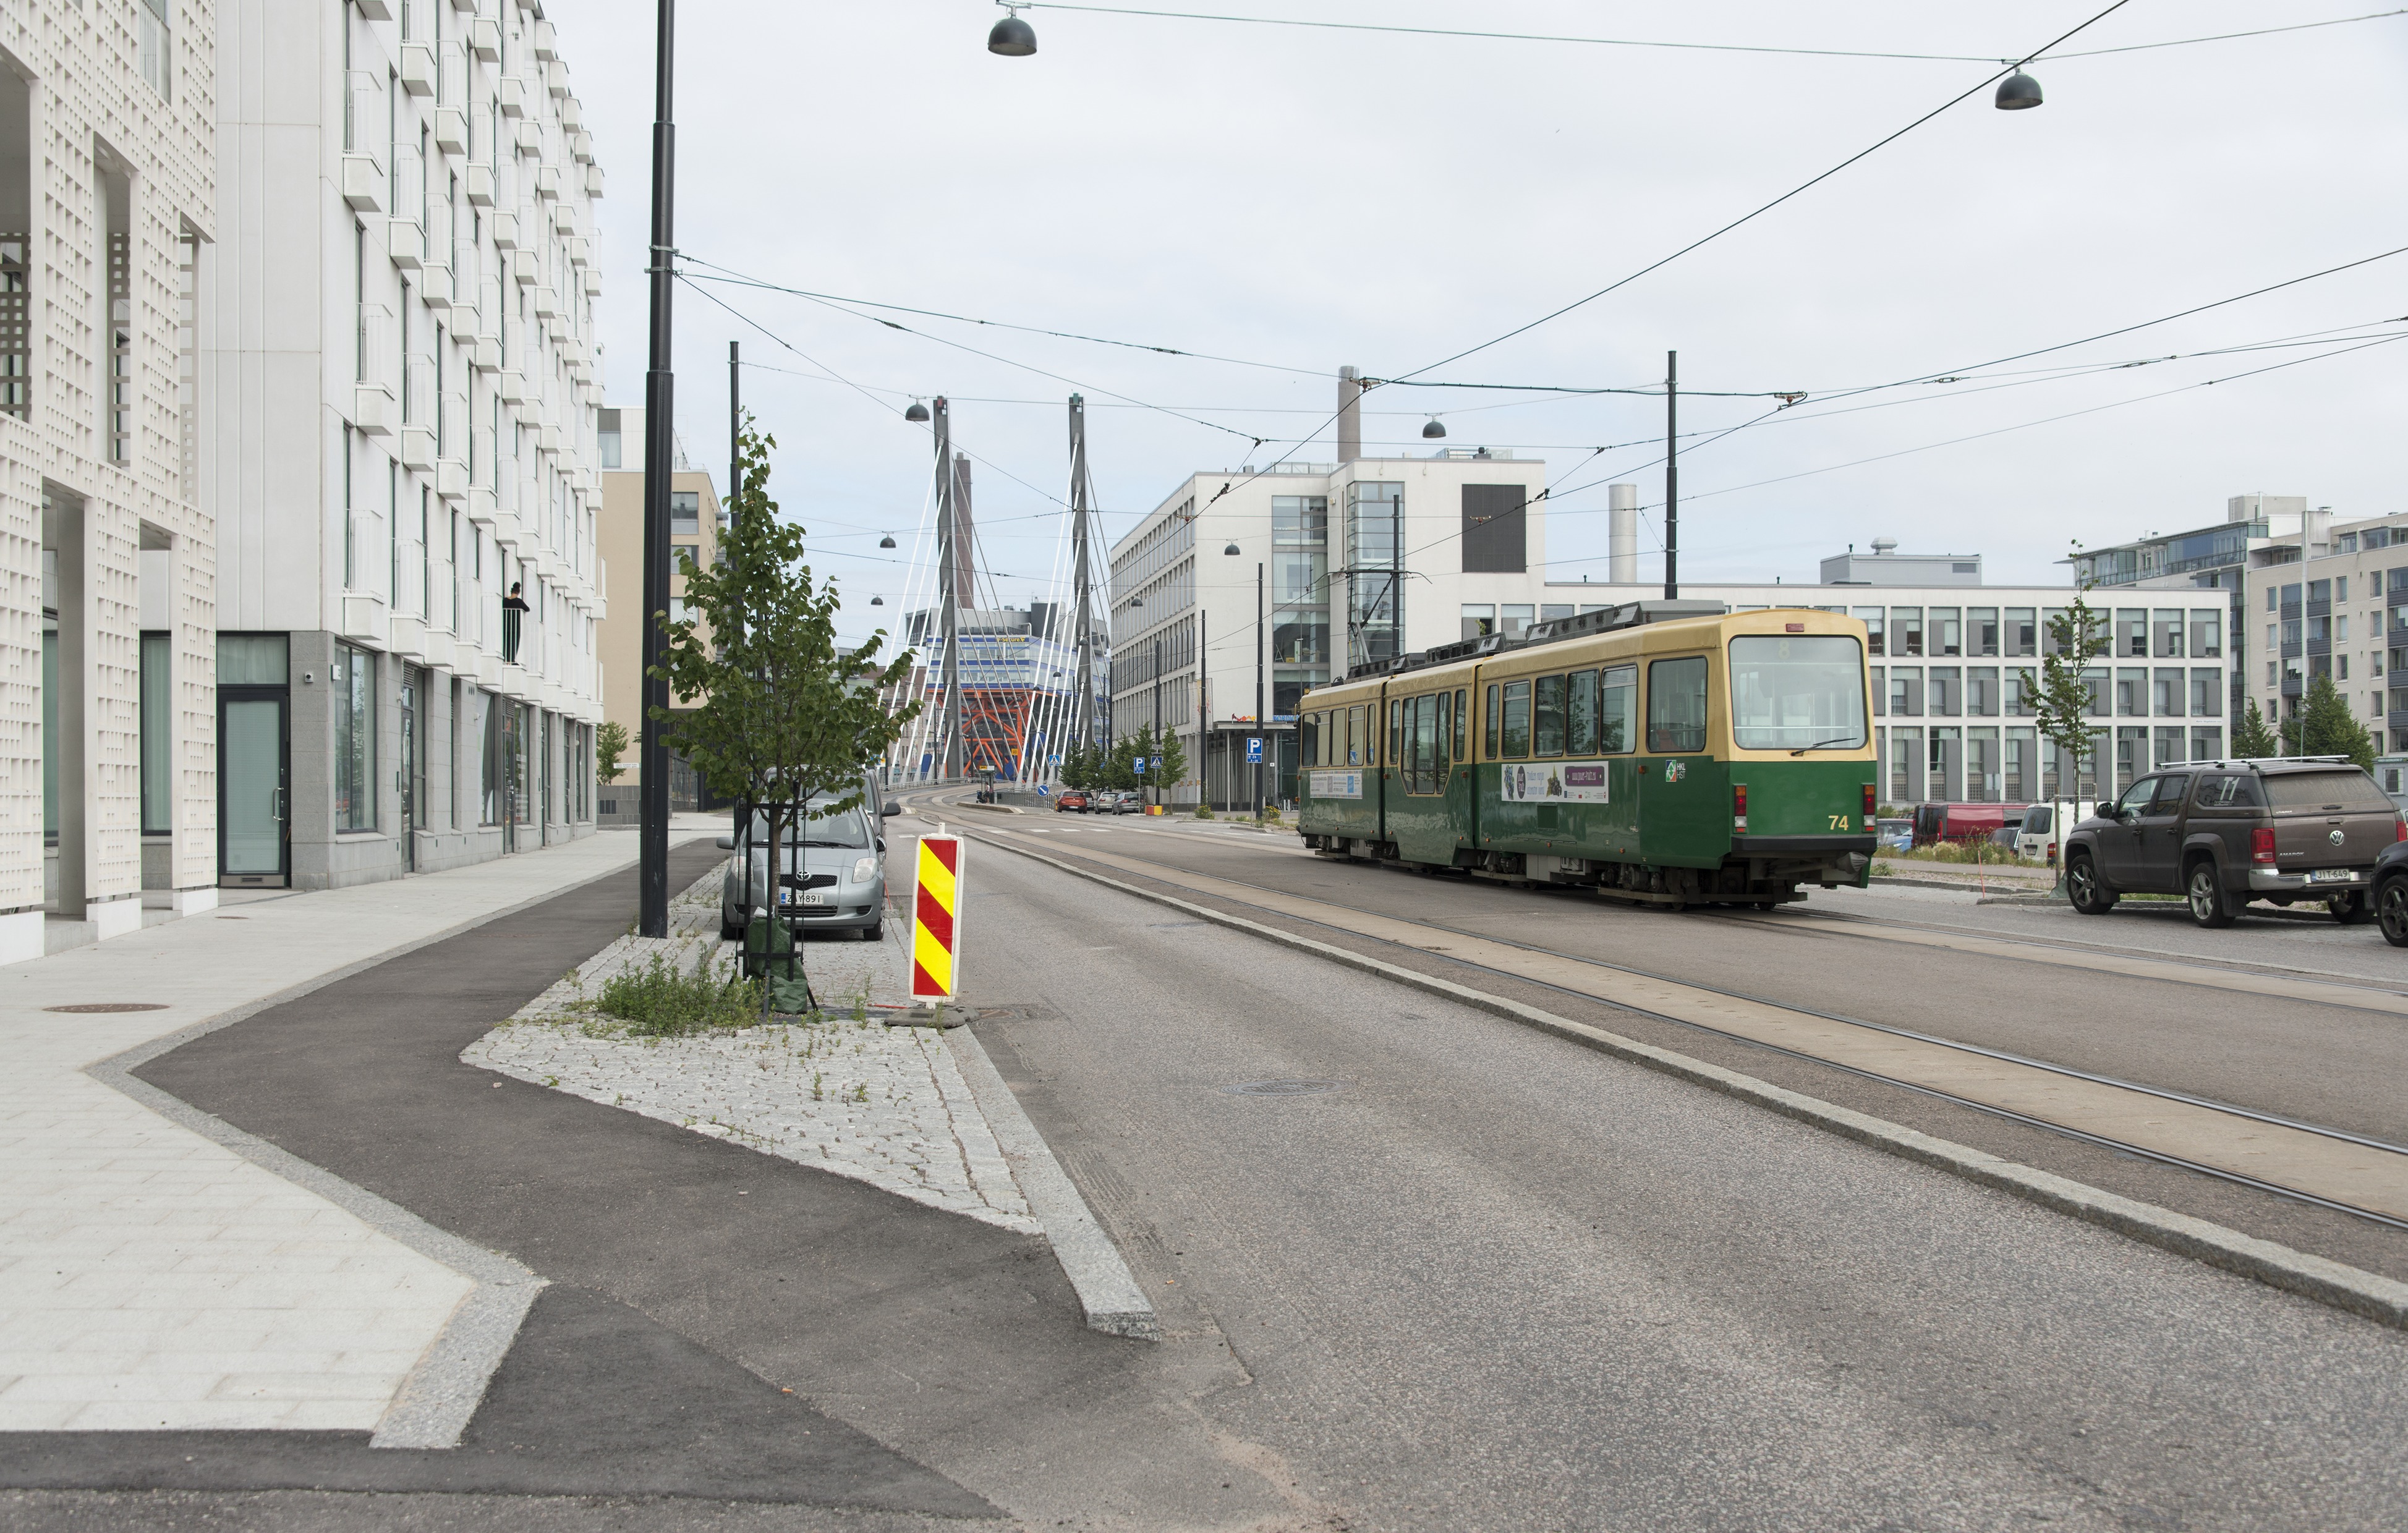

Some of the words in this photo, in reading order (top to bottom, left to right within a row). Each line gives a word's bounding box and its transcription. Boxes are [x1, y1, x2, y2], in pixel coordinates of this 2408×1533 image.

[1778, 639, 1790, 660] 8
[1250, 739, 1261, 753] P
[1136, 758, 1143, 767] P
[1677, 763, 1686, 771] HKL
[1677, 771, 1686, 779] HST
[2219, 776, 2240, 801] T1
[1828, 815, 1849, 831] 74
[2317, 870, 2348, 879] JIT-649
[787, 894, 820, 903] ZY-891
